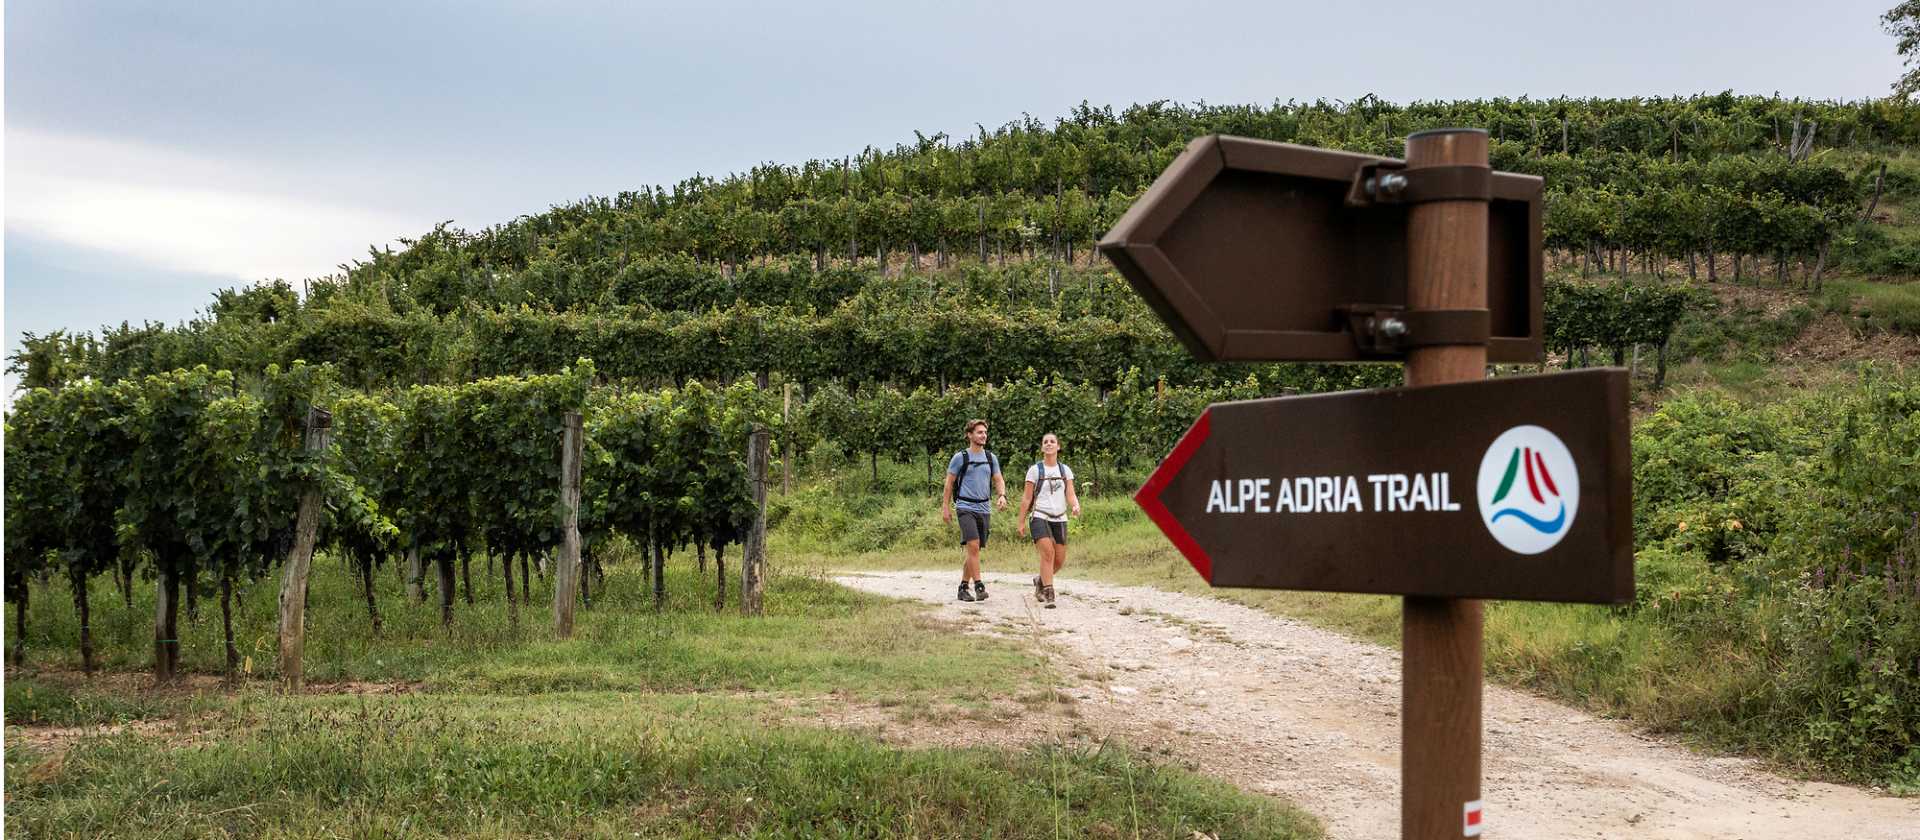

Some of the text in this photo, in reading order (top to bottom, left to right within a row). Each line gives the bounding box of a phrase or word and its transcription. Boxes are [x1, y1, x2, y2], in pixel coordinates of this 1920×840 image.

[1206, 472, 1461, 513] ALPE ADRIA TRAIL
